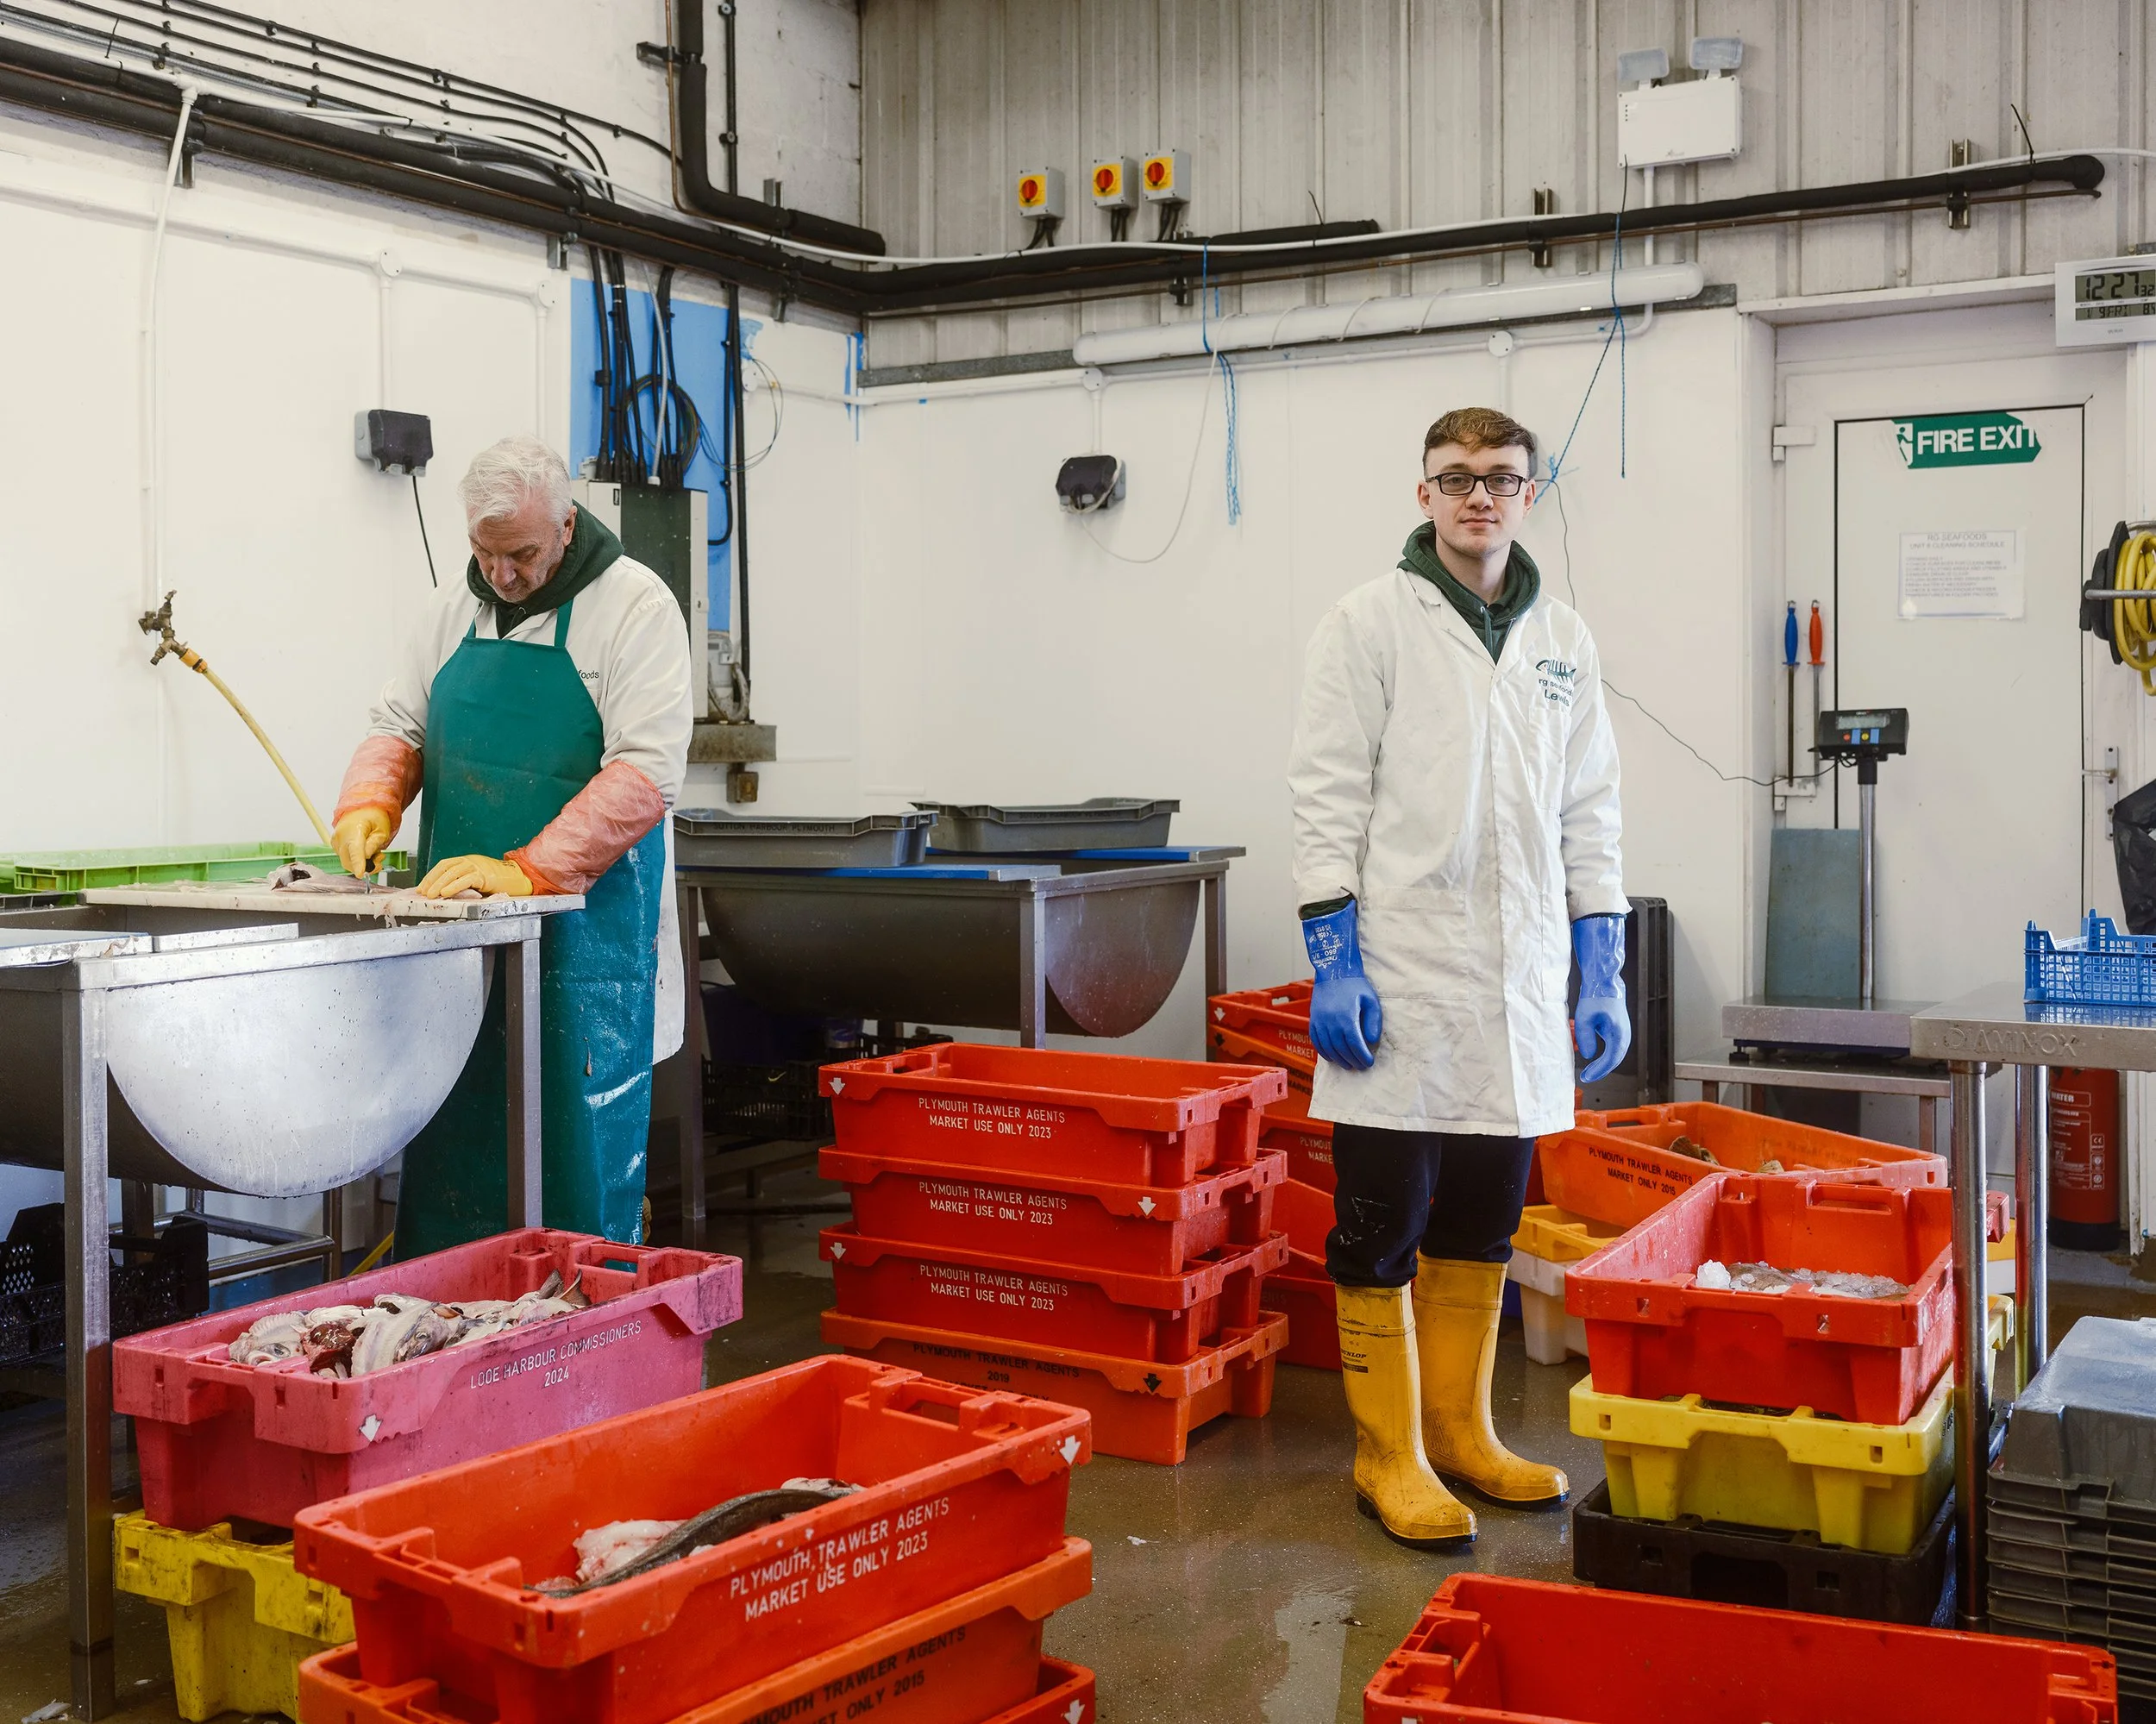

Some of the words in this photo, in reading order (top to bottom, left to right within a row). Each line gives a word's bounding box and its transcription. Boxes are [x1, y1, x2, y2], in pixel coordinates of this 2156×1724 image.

[1917, 428, 1975, 455] FIRE
[1980, 424, 2035, 451] EXIT
[1941, 533, 1987, 542] SEAFOODS
[579, 669, 599, 680] foods
[1539, 678, 1548, 686] rg
[713, 822, 746, 831] SUTTON
[749, 823, 787, 831] HARBOUR
[791, 823, 835, 832] PLYMOUTH
[1286, 1044, 1314, 1059] MARKET
[918, 1097, 968, 1113] PLYMOUTH
[973, 1102, 1021, 1119] TRAWLER
[1026, 1108, 1066, 1124] AGENTS
[929, 1114, 968, 1130] MARKET
[974, 1119, 993, 1132] USE
[998, 1122, 1024, 1135] ONLY
[1028, 1125, 1051, 1139] 2023
[1299, 1137, 1332, 1150] PLYMOUT
[1307, 1150, 1333, 1164] MARKE
[1589, 1147, 1624, 1164] PLYMOUTH
[1626, 1157, 1662, 1175] TRAWLER
[1664, 1169, 1693, 1186] AGENTS
[1607, 1167, 1634, 1183] MARKET
[1638, 1176, 1658, 1190] ONLY
[1661, 1183, 1676, 1196] 2015
[919, 1182, 969, 1198] PLYMOUTH
[974, 1188, 1023, 1205] TRAWLER
[1027, 1194, 1067, 1210] AGENTS
[930, 1199, 969, 1214] MARKET
[975, 1204, 994, 1218] USE
[999, 1207, 1025, 1220] ONLY
[1030, 1211, 1053, 1226] 2023
[919, 1264, 970, 1282] PLYMOUTH
[975, 1272, 1024, 1290] TRAWLER
[1028, 1281, 1068, 1296] AGENTS
[931, 1282, 970, 1298] MARKET
[975, 1288, 995, 1303] USE
[1000, 1292, 1025, 1307] ONLY
[1031, 1296, 1055, 1311] 2023
[470, 1366, 500, 1389] LOOE
[504, 1348, 556, 1381] HARBOUR
[560, 1320, 642, 1360] COMMISSIONERS
[912, 1343, 971, 1360] PLYMOUTH
[976, 1351, 1029, 1370] TRAWLER
[1035, 1359, 1080, 1377] AGENTS
[544, 1365, 569, 1388] 2024
[987, 1370, 1010, 1383] 2019
[730, 1550, 812, 1600] PLYMOUTH
[818, 1519, 888, 1564] TRAWLER
[895, 1496, 950, 1533] AGENTS
[744, 1577, 808, 1622] MARKET
[817, 1563, 846, 1594] USE
[852, 1545, 890, 1578] ONLY
[896, 1531, 929, 1562] 2023
[823, 1654, 898, 1702] TRAWLER
[906, 1626, 967, 1664] AGENTS
[846, 1688, 886, 1721] ONLY
[893, 1669, 925, 1697] 2015
